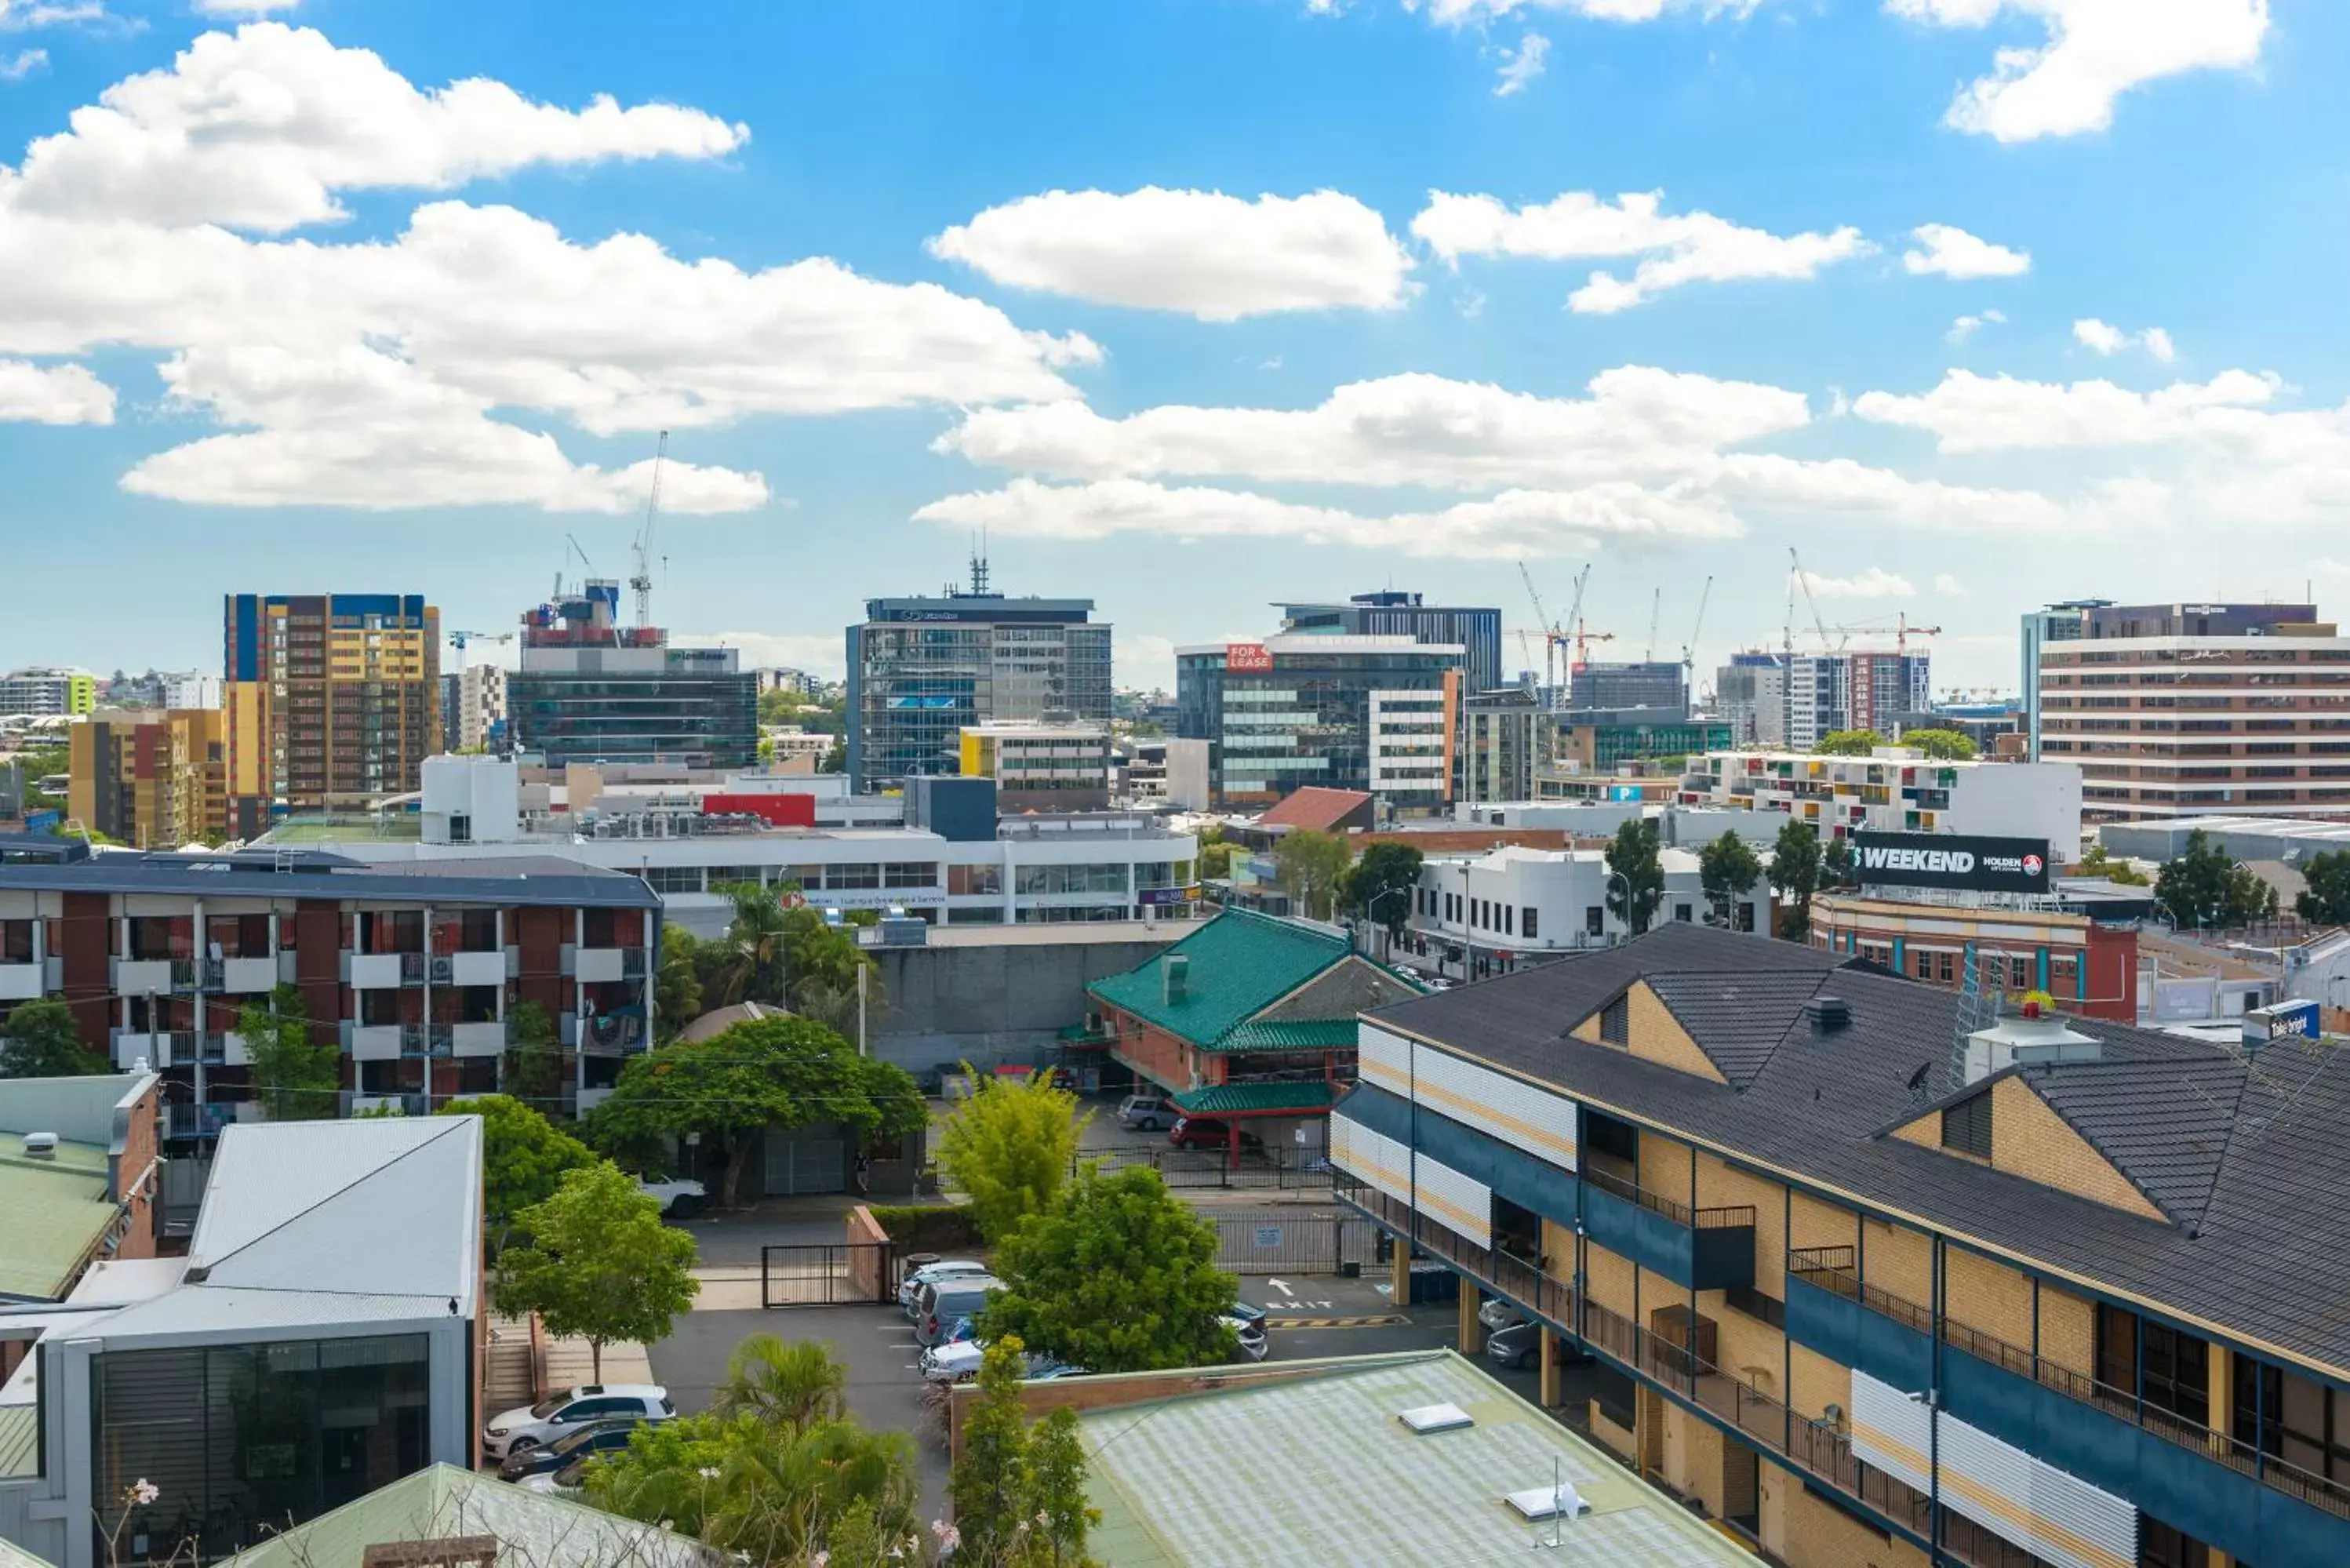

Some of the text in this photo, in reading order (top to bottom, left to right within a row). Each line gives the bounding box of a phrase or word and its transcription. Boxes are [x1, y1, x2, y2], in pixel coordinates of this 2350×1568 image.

[1231, 646, 1255, 657] FOR
[1230, 657, 1268, 667] LEASE
[1863, 847, 1975, 873] WEEKEND
[1982, 856, 2021, 867] HOLDEN
[1265, 1301, 1333, 1309] EXIT
